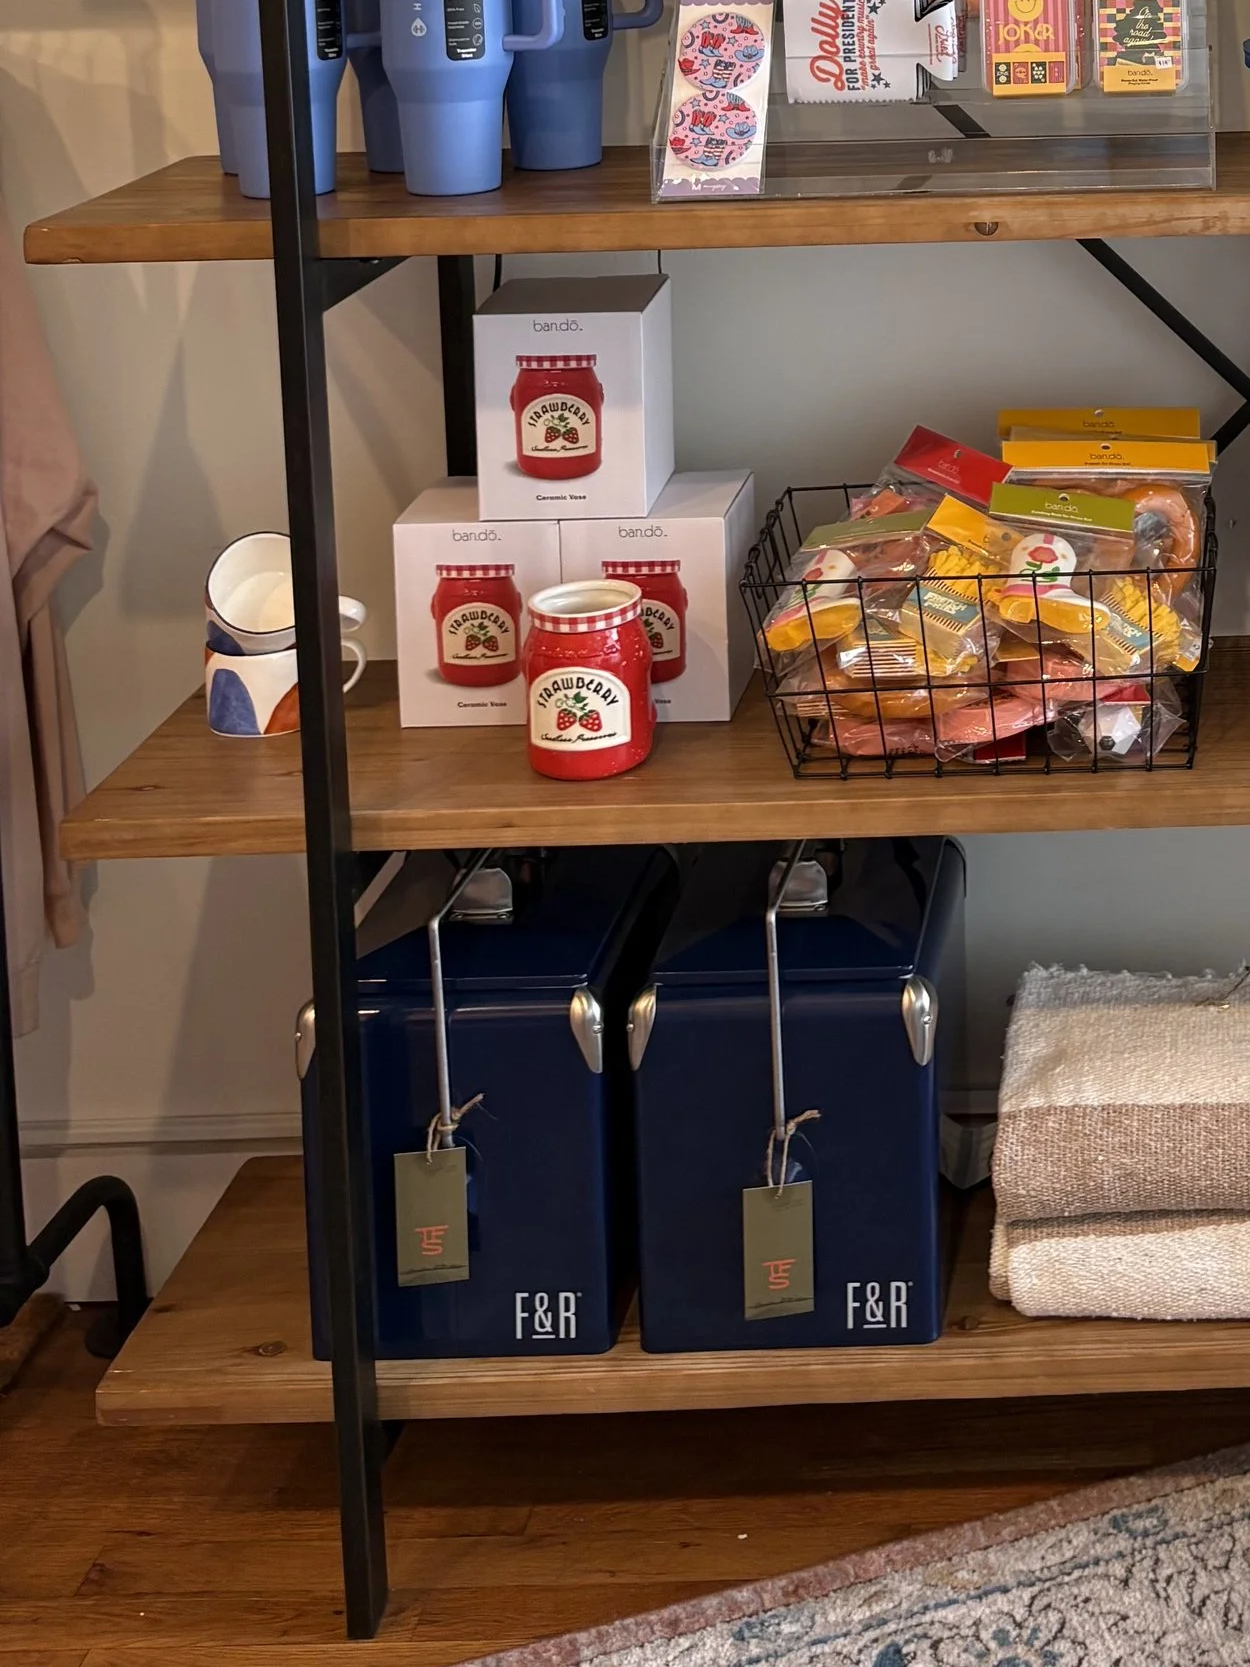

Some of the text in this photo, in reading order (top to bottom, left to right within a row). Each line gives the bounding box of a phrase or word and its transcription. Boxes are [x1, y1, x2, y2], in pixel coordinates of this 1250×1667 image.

[1136, 6, 1152, 18] On
[857, 25, 867, 59] country
[999, 22, 1055, 43] JOKER
[1130, 27, 1152, 38] road
[868, 43, 881, 71] great
[845, 68, 861, 91] FOR
[528, 401, 590, 427] STRAWBERRY
[448, 609, 510, 636] STRAWBERRY
[457, 700, 507, 708] Ceramic Vase
[536, 676, 619, 709] STRAWBERRY
[515, 1291, 578, 1340] F&R
[847, 1281, 909, 1330] F&R
